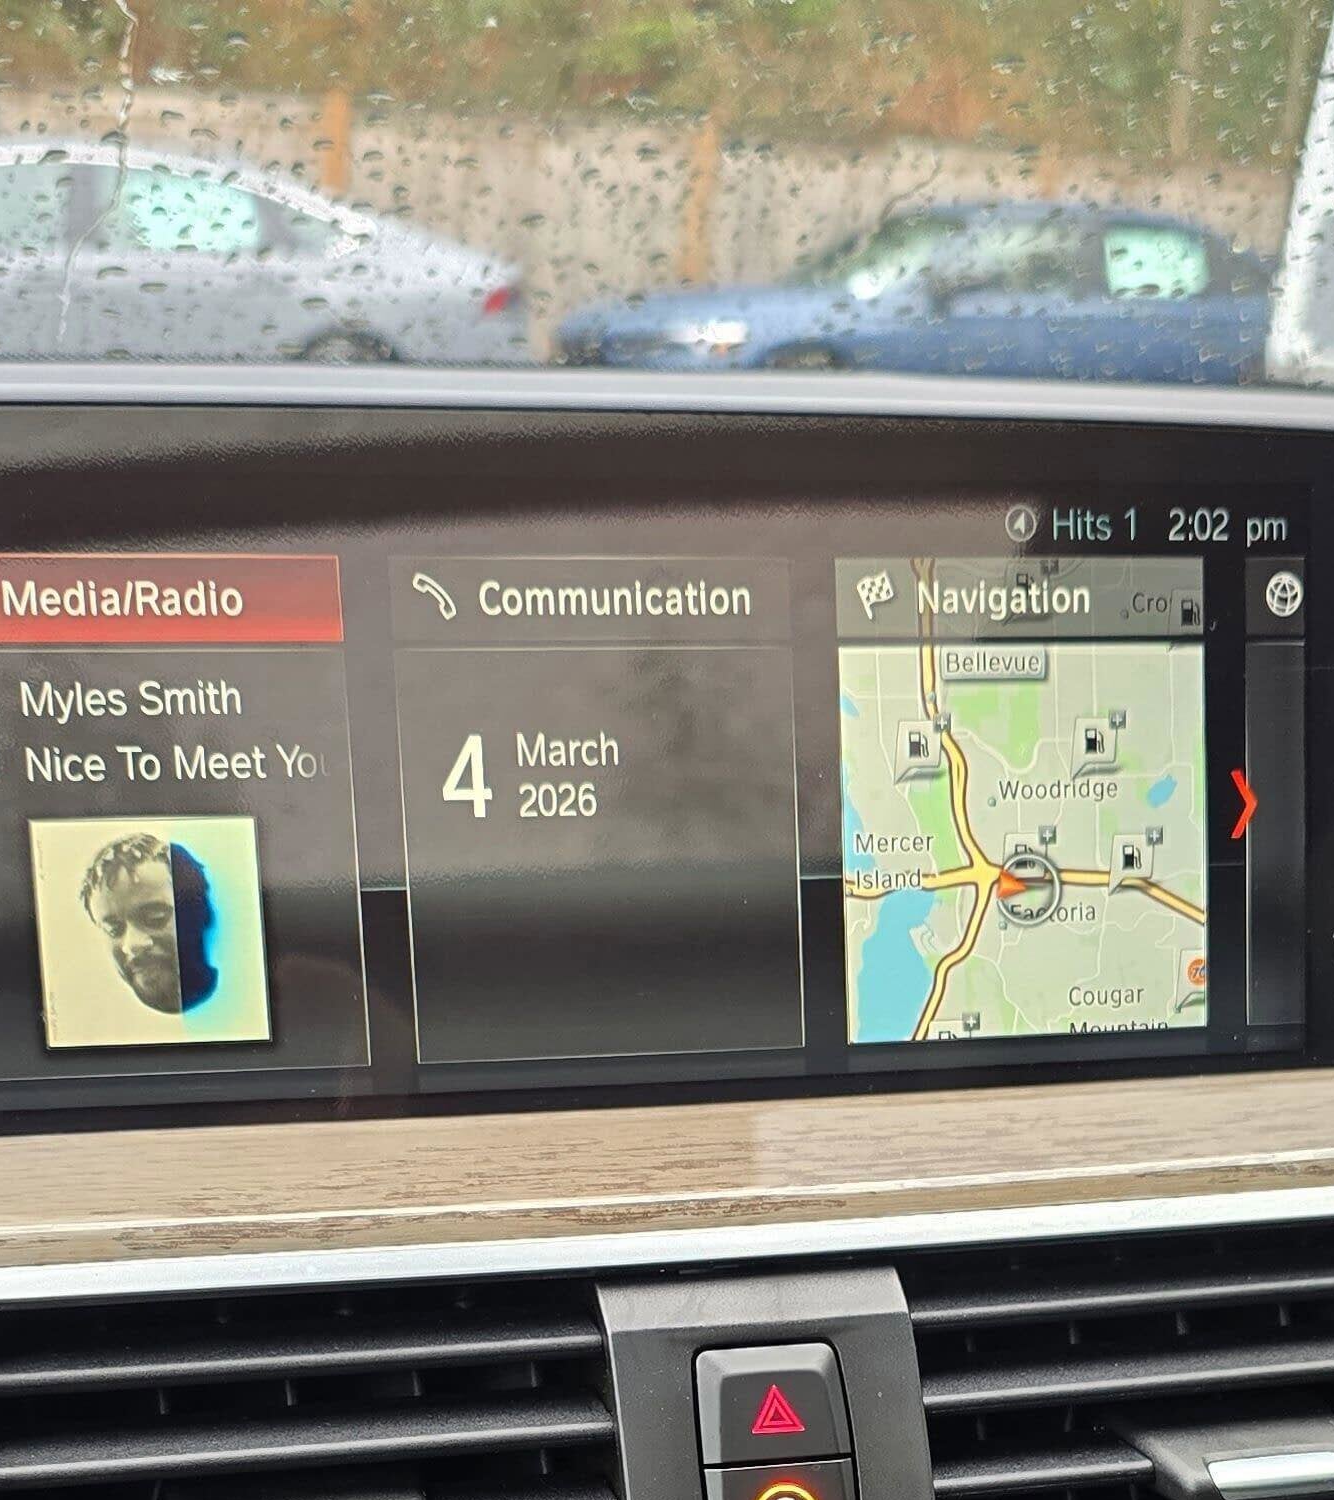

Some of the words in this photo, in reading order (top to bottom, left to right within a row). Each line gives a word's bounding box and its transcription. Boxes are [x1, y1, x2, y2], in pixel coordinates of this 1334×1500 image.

[1052, 507, 1112, 541] Hits
[1124, 508, 1137, 540] 1
[1168, 508, 1230, 541] 2:02
[1246, 515, 1288, 547] pm
[1, 580, 244, 617] Media/Radio
[478, 580, 752, 617] Communication
[917, 580, 1091, 621] Navigation
[1132, 592, 1172, 613] Cro
[945, 652, 1040, 673] Bellevue
[20, 681, 127, 724] Myles
[138, 680, 242, 716] Smith
[24, 747, 105, 783] Nice
[116, 746, 162, 782] To
[174, 744, 267, 780] Meet
[515, 731, 620, 768] March
[441, 733, 493, 818] 4
[998, 779, 1118, 803] Woodridge
[518, 783, 598, 818] 2026
[855, 833, 934, 853] Mercer
[855, 868, 922, 890] Island
[1068, 986, 1145, 1009] Cougar
